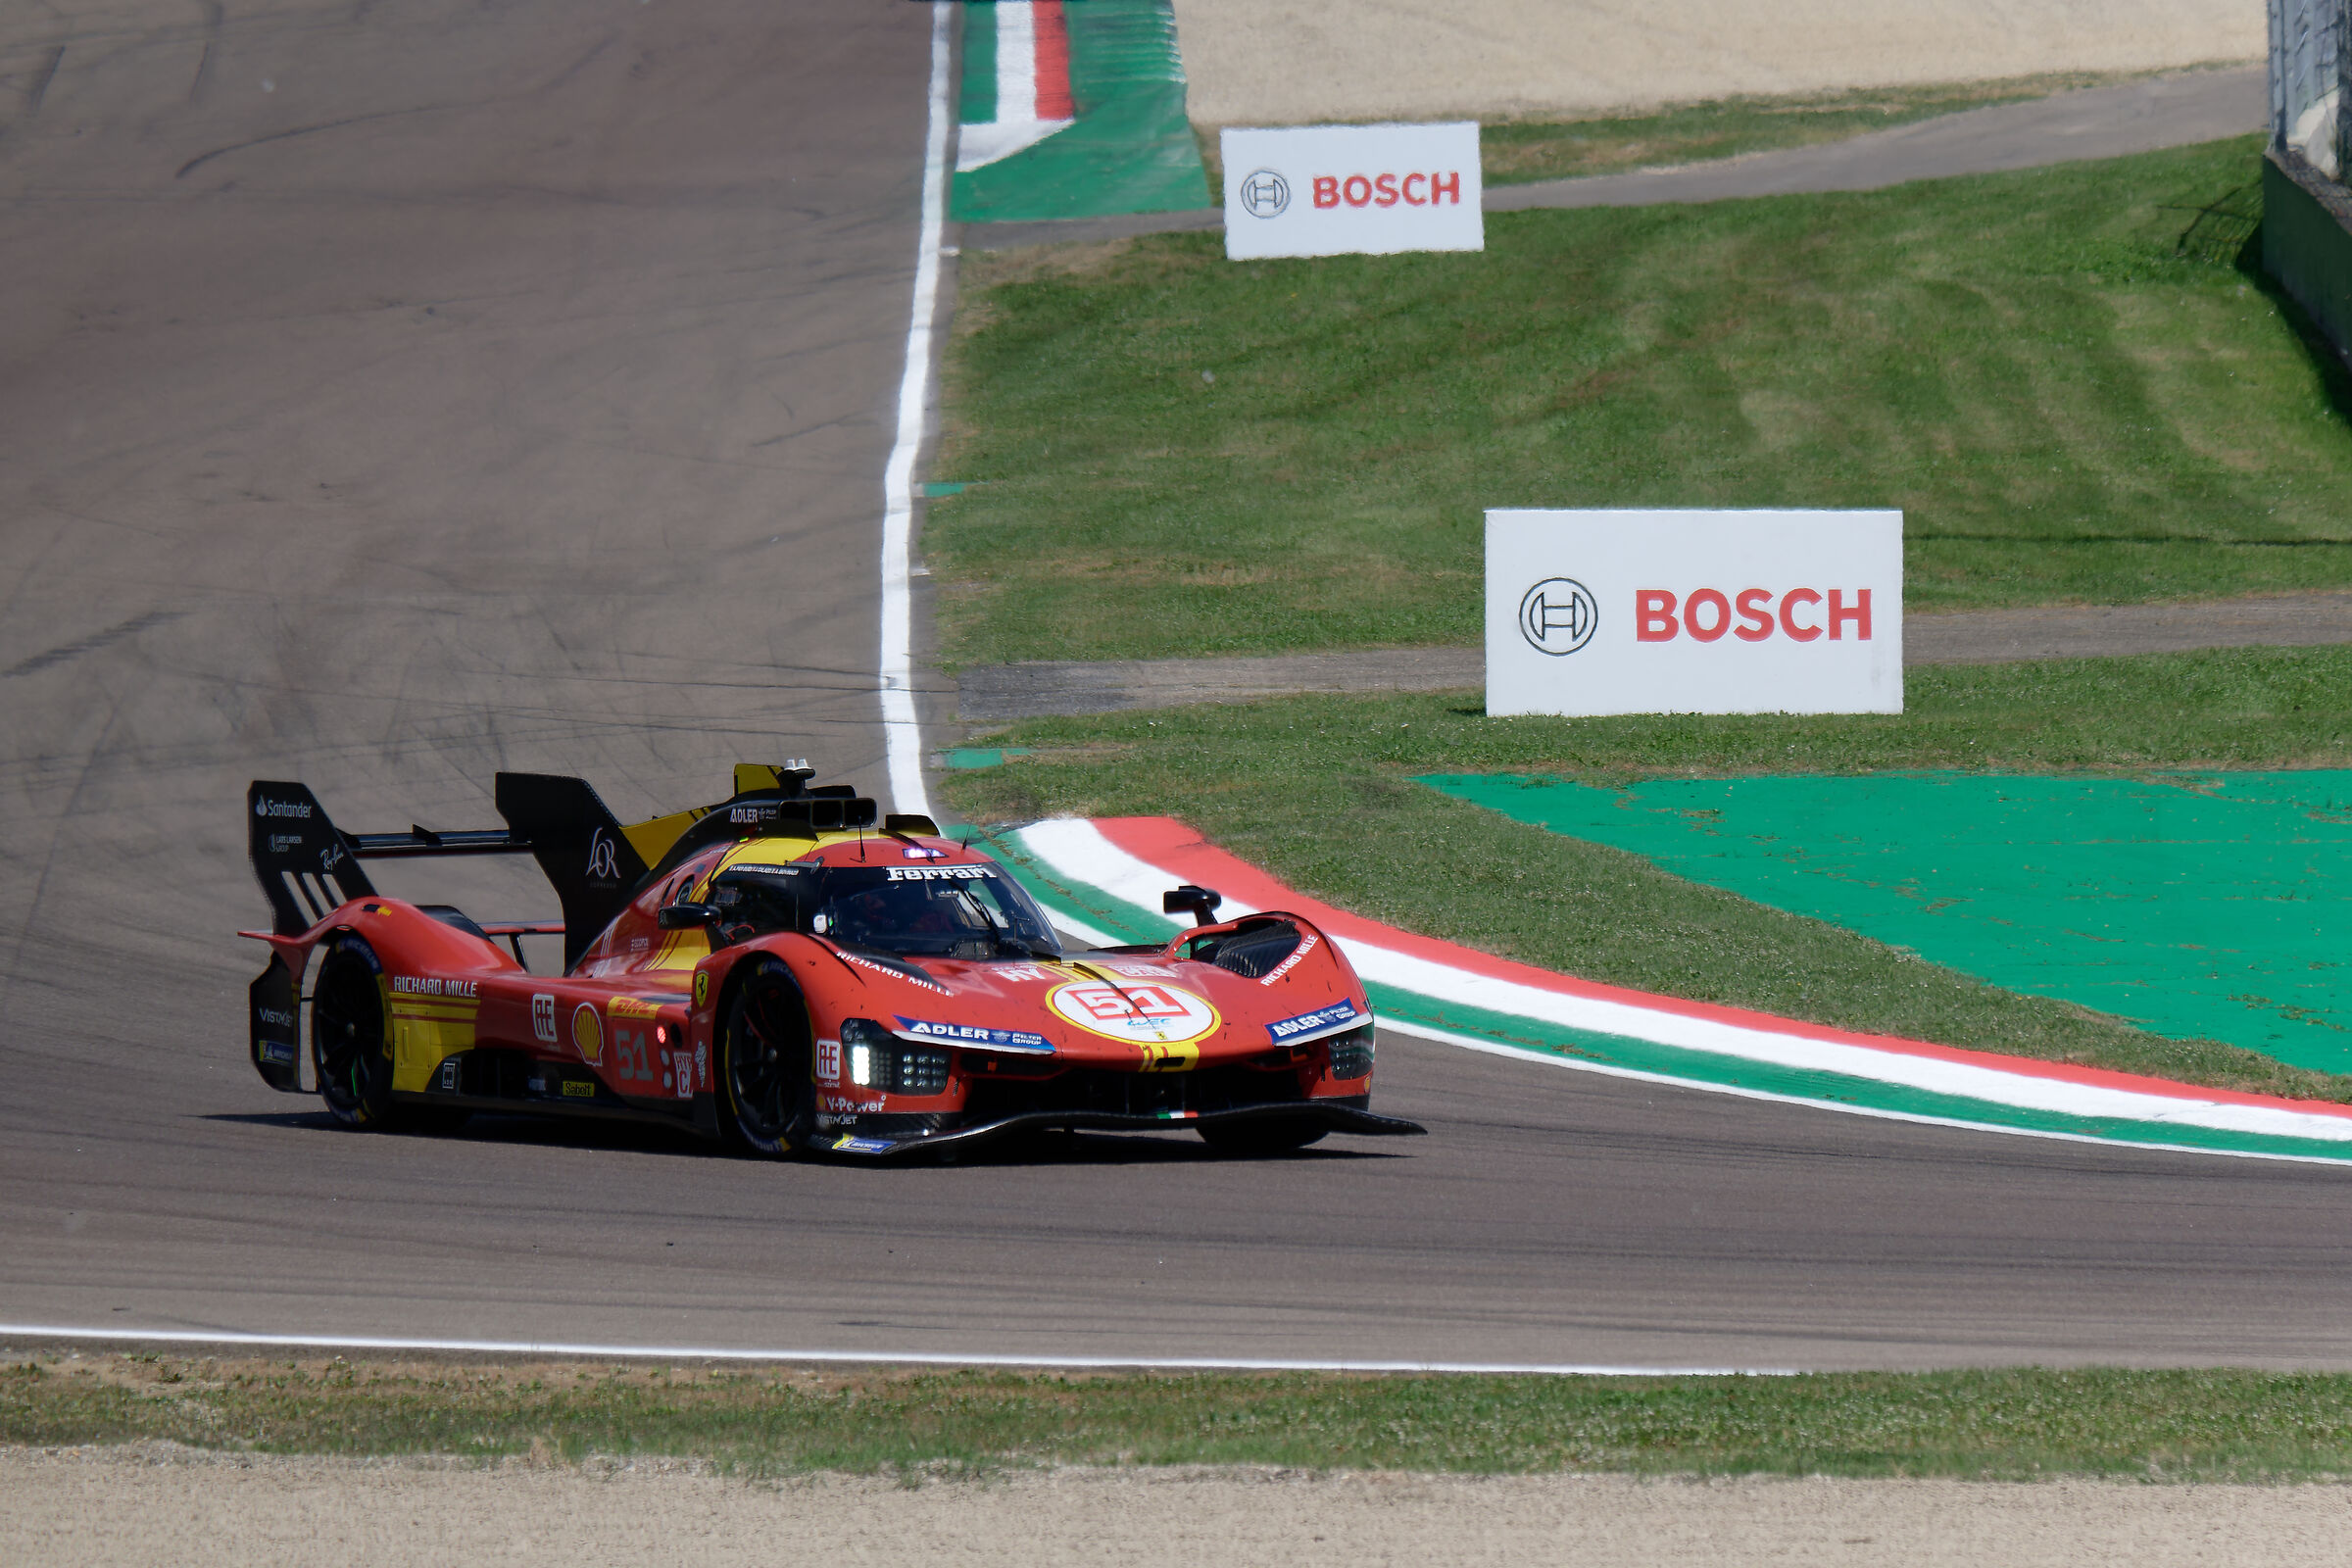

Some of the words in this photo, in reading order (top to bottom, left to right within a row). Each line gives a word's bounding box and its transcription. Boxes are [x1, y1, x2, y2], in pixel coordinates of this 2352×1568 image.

[1312, 171, 1460, 209] BOSCH
[1636, 588, 1872, 643] BOSCH
[267, 799, 312, 818] Santander
[730, 808, 759, 823] ADLER
[886, 864, 998, 881] Ferrari
[1259, 955, 1302, 987] RICHARD
[1297, 933, 1319, 956] MILLE
[394, 976, 442, 996] RICHARD
[445, 980, 478, 998] MILLE
[835, 951, 904, 980] RICHARD
[907, 976, 956, 998] MILLE
[1074, 988, 1185, 1017] 51
[909, 1022, 990, 1040] ADLER
[1272, 1014, 1326, 1038] ADLER
[614, 1030, 655, 1082] 51
